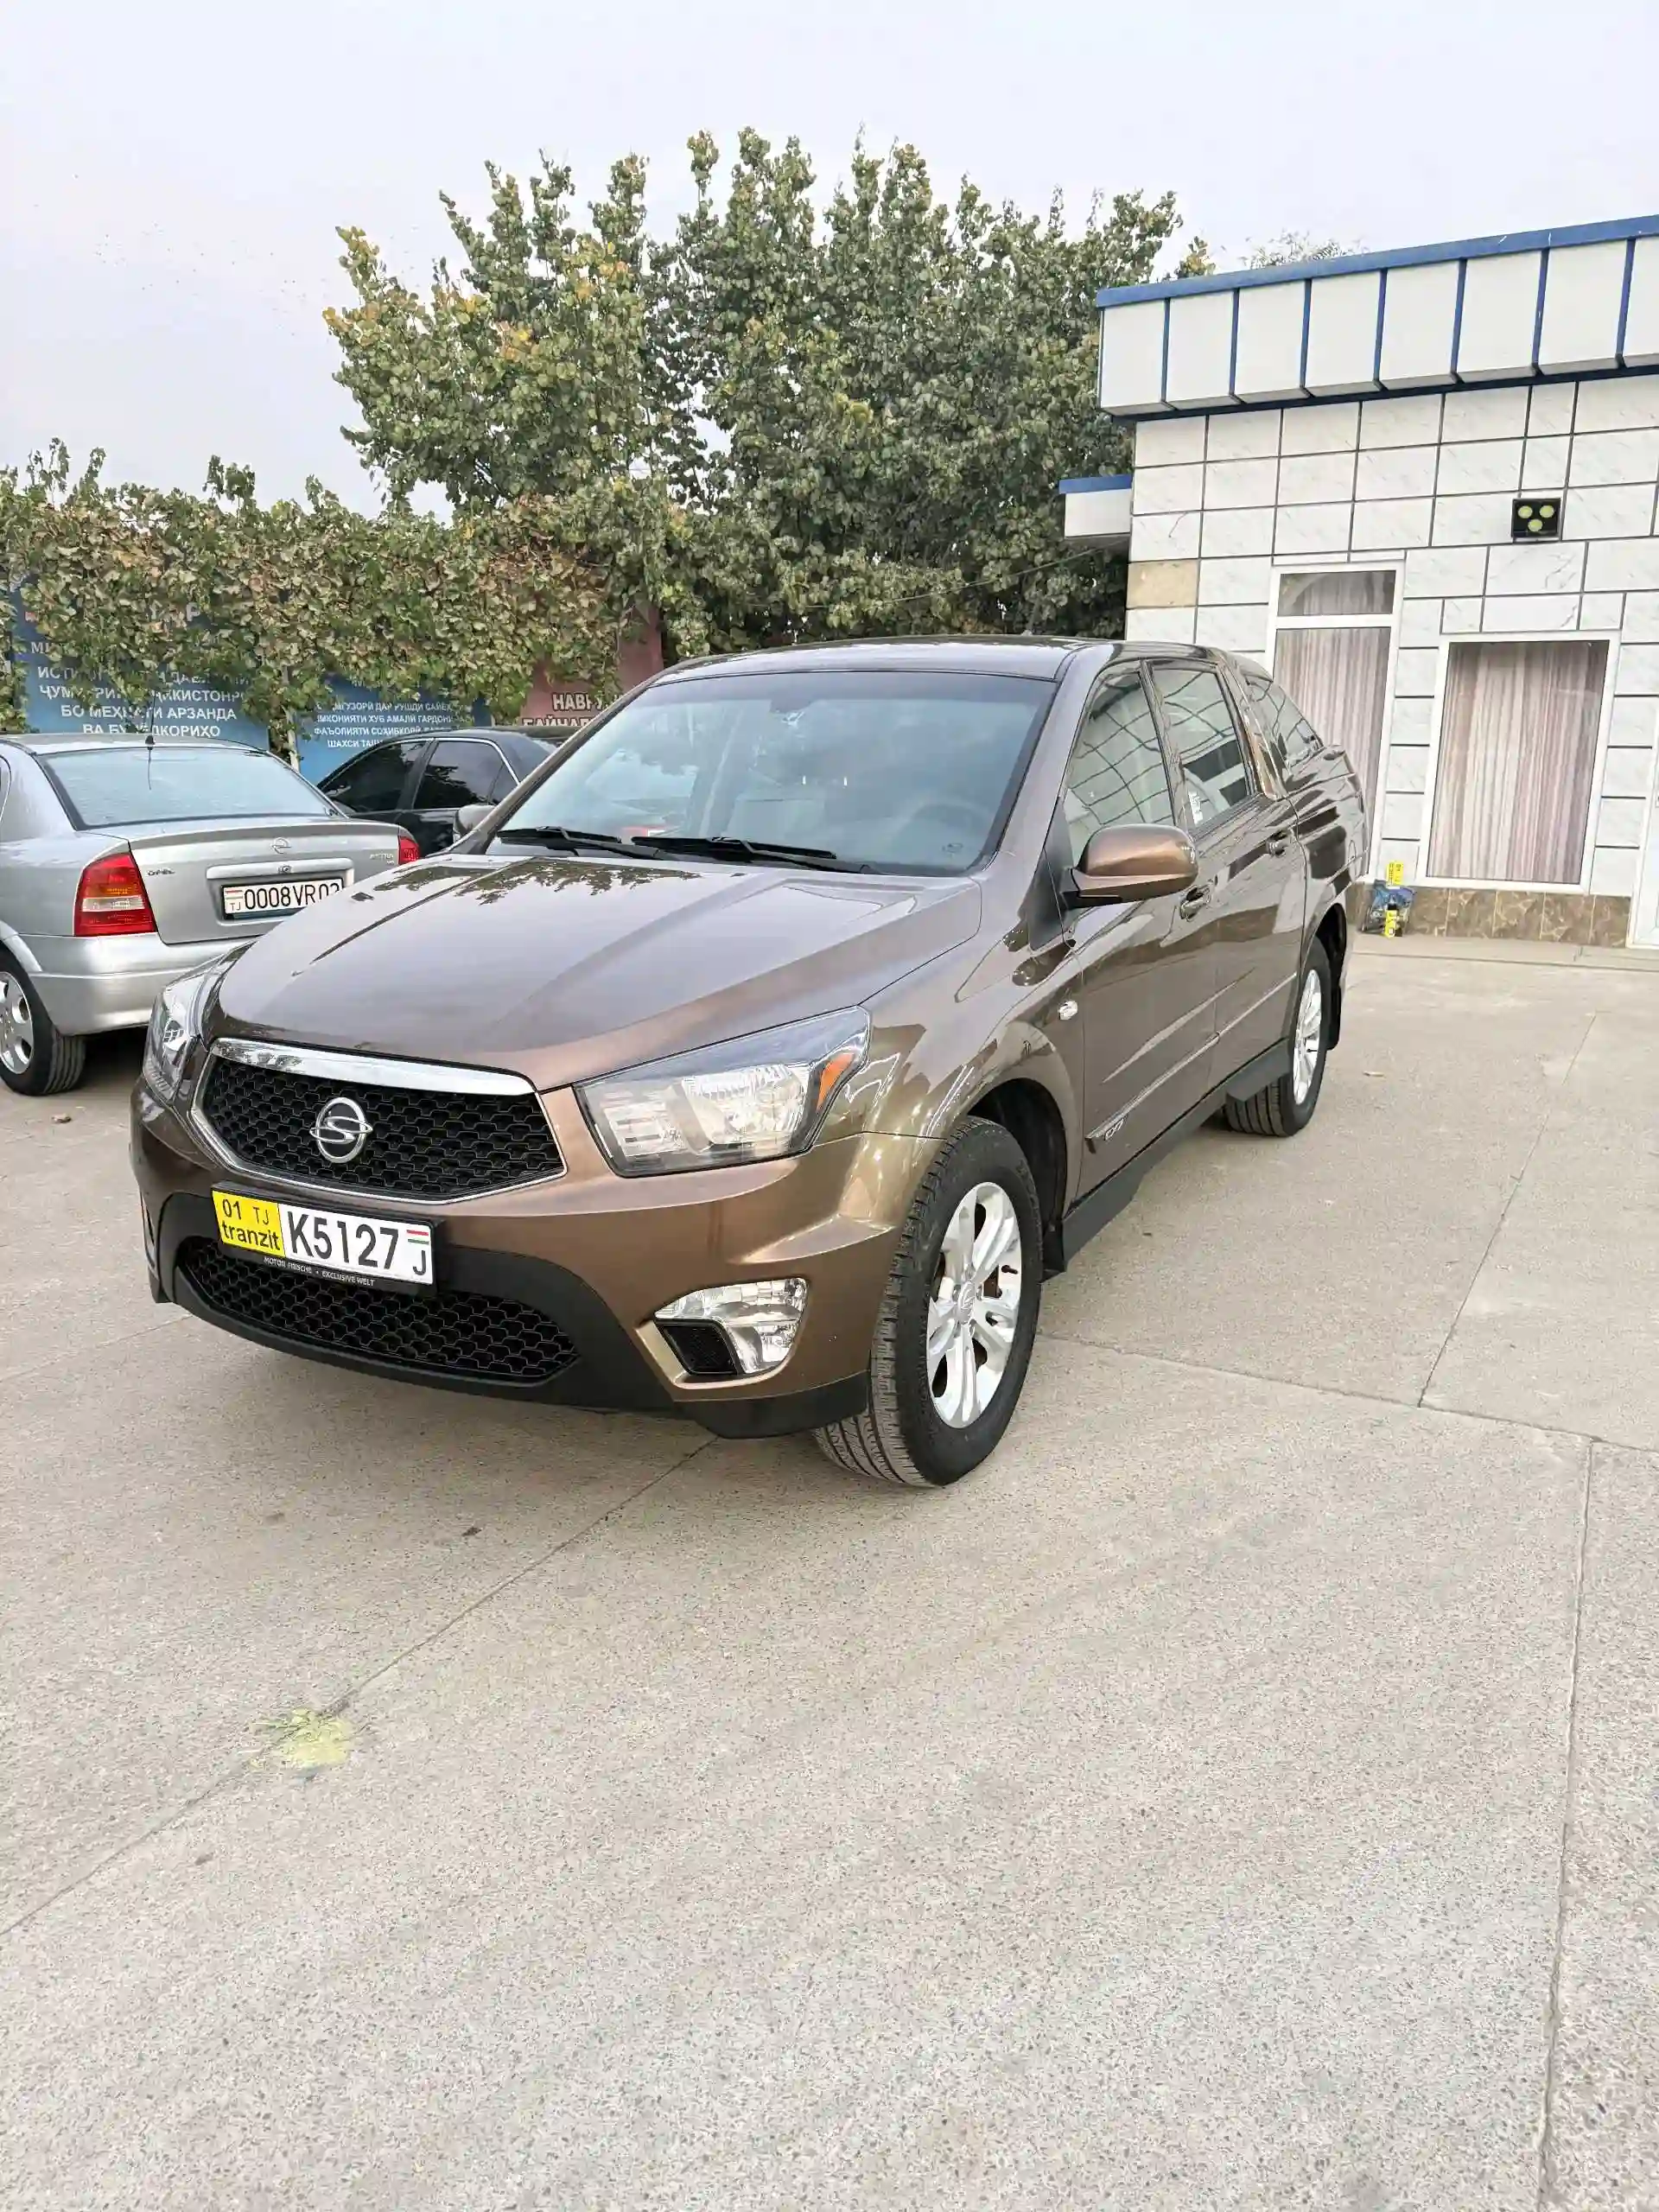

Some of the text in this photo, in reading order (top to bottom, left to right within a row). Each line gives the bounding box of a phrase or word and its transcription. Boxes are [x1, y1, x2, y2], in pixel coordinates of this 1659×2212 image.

[60, 704, 85, 718] БО
[167, 707, 238, 721] АРЗАНДА
[229, 902, 241, 911] TJ
[221, 1198, 270, 1226] 01 TJ
[221, 1221, 281, 1252] tranzit
[287, 1211, 399, 1269] K5127
[412, 1249, 427, 1276] J
[355, 1276, 375, 1287] WELT
